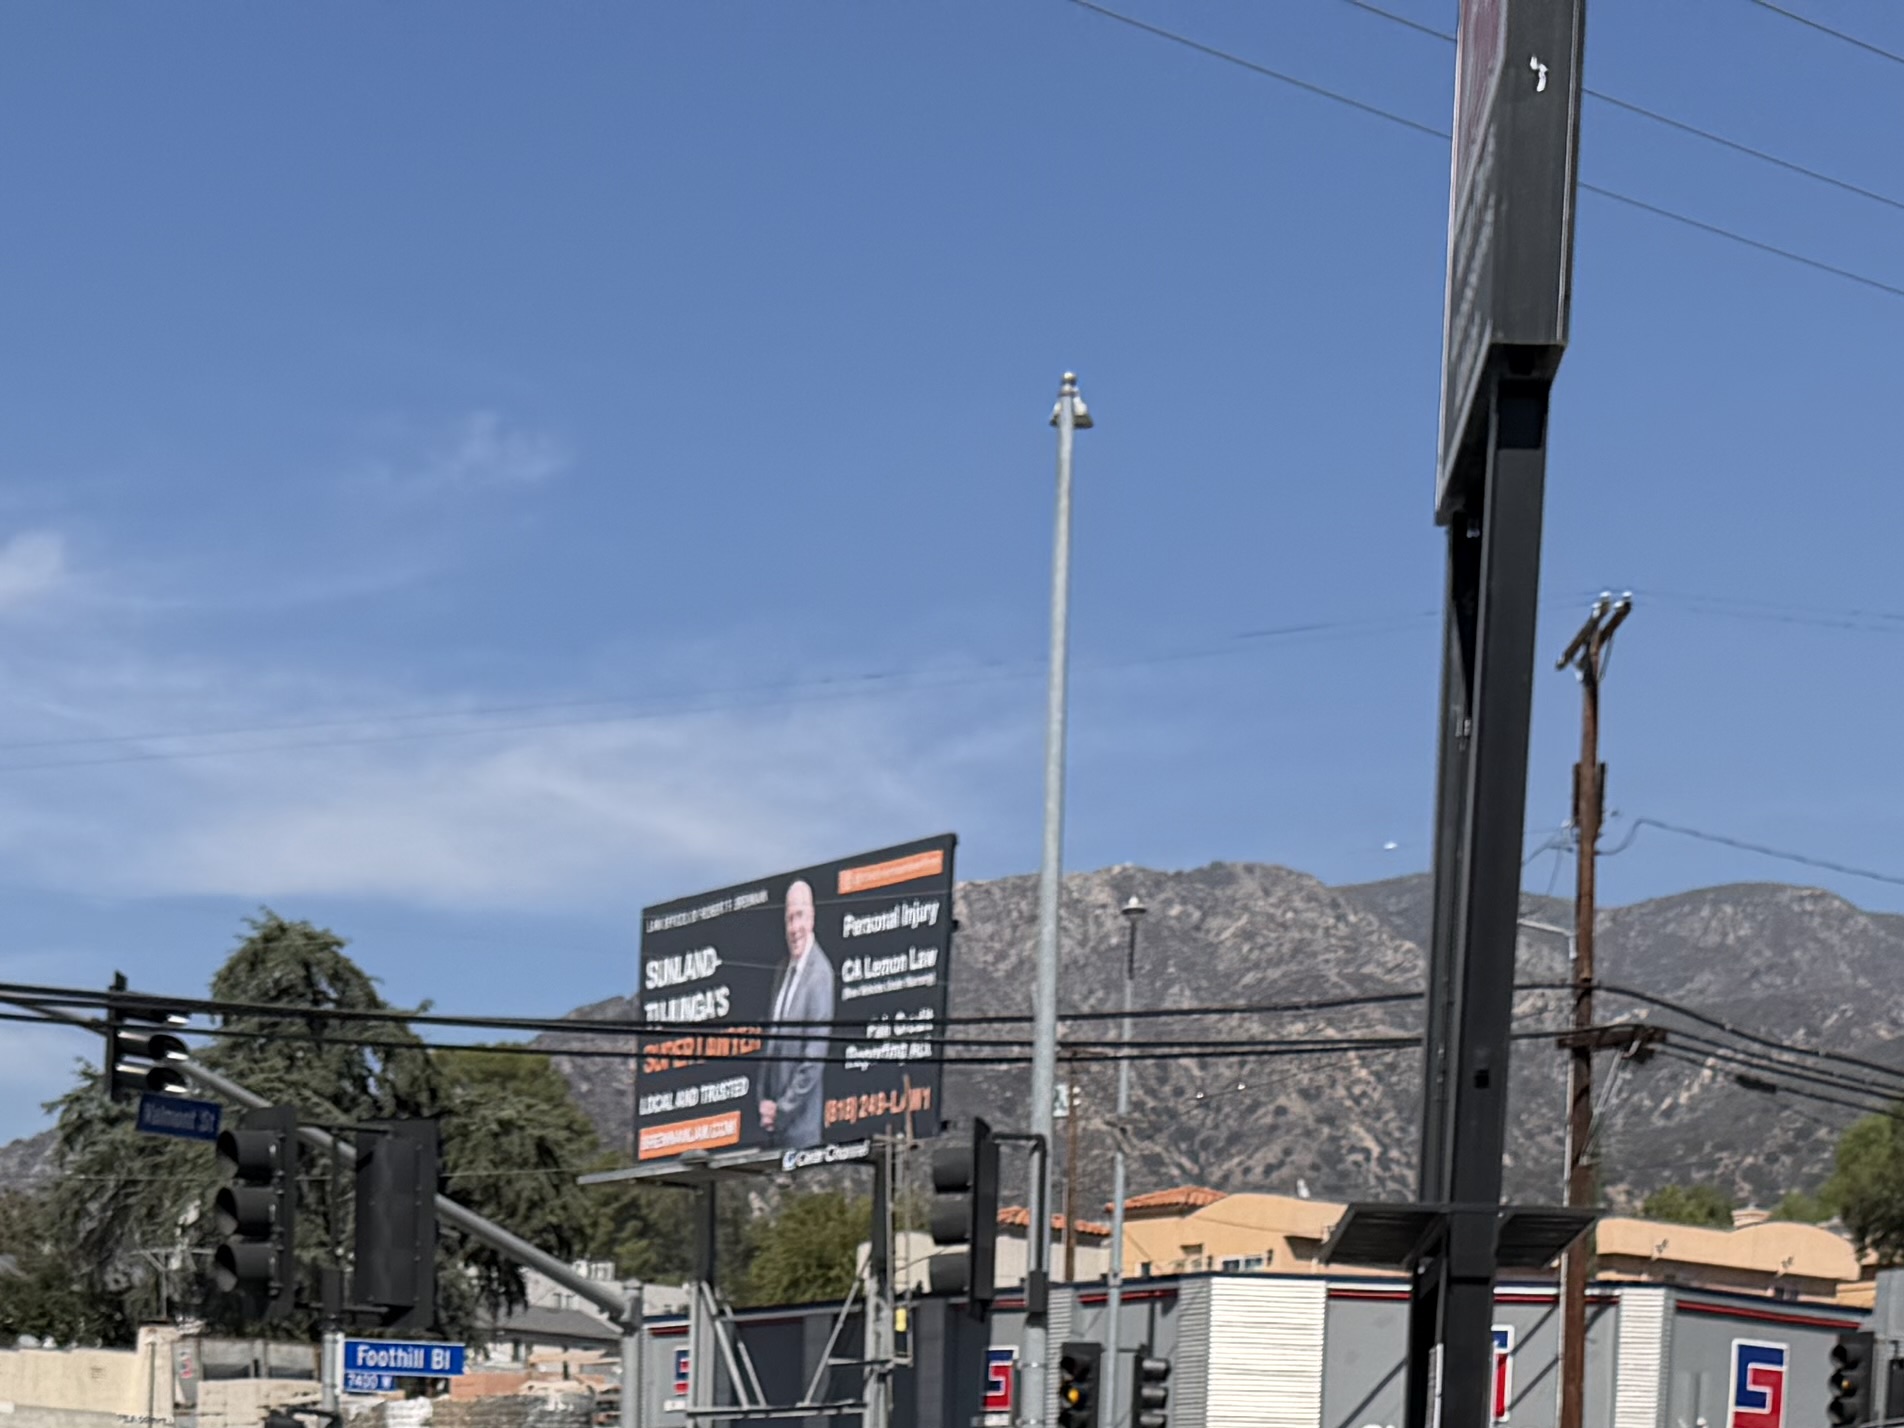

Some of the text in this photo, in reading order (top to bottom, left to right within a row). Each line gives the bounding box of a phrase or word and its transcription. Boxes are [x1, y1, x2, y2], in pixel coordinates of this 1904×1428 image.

[843, 900, 940, 938] Personal Injury
[864, 953, 908, 980] Lemon
[909, 946, 938, 971] Law
[356, 1344, 425, 1369] Foothill
